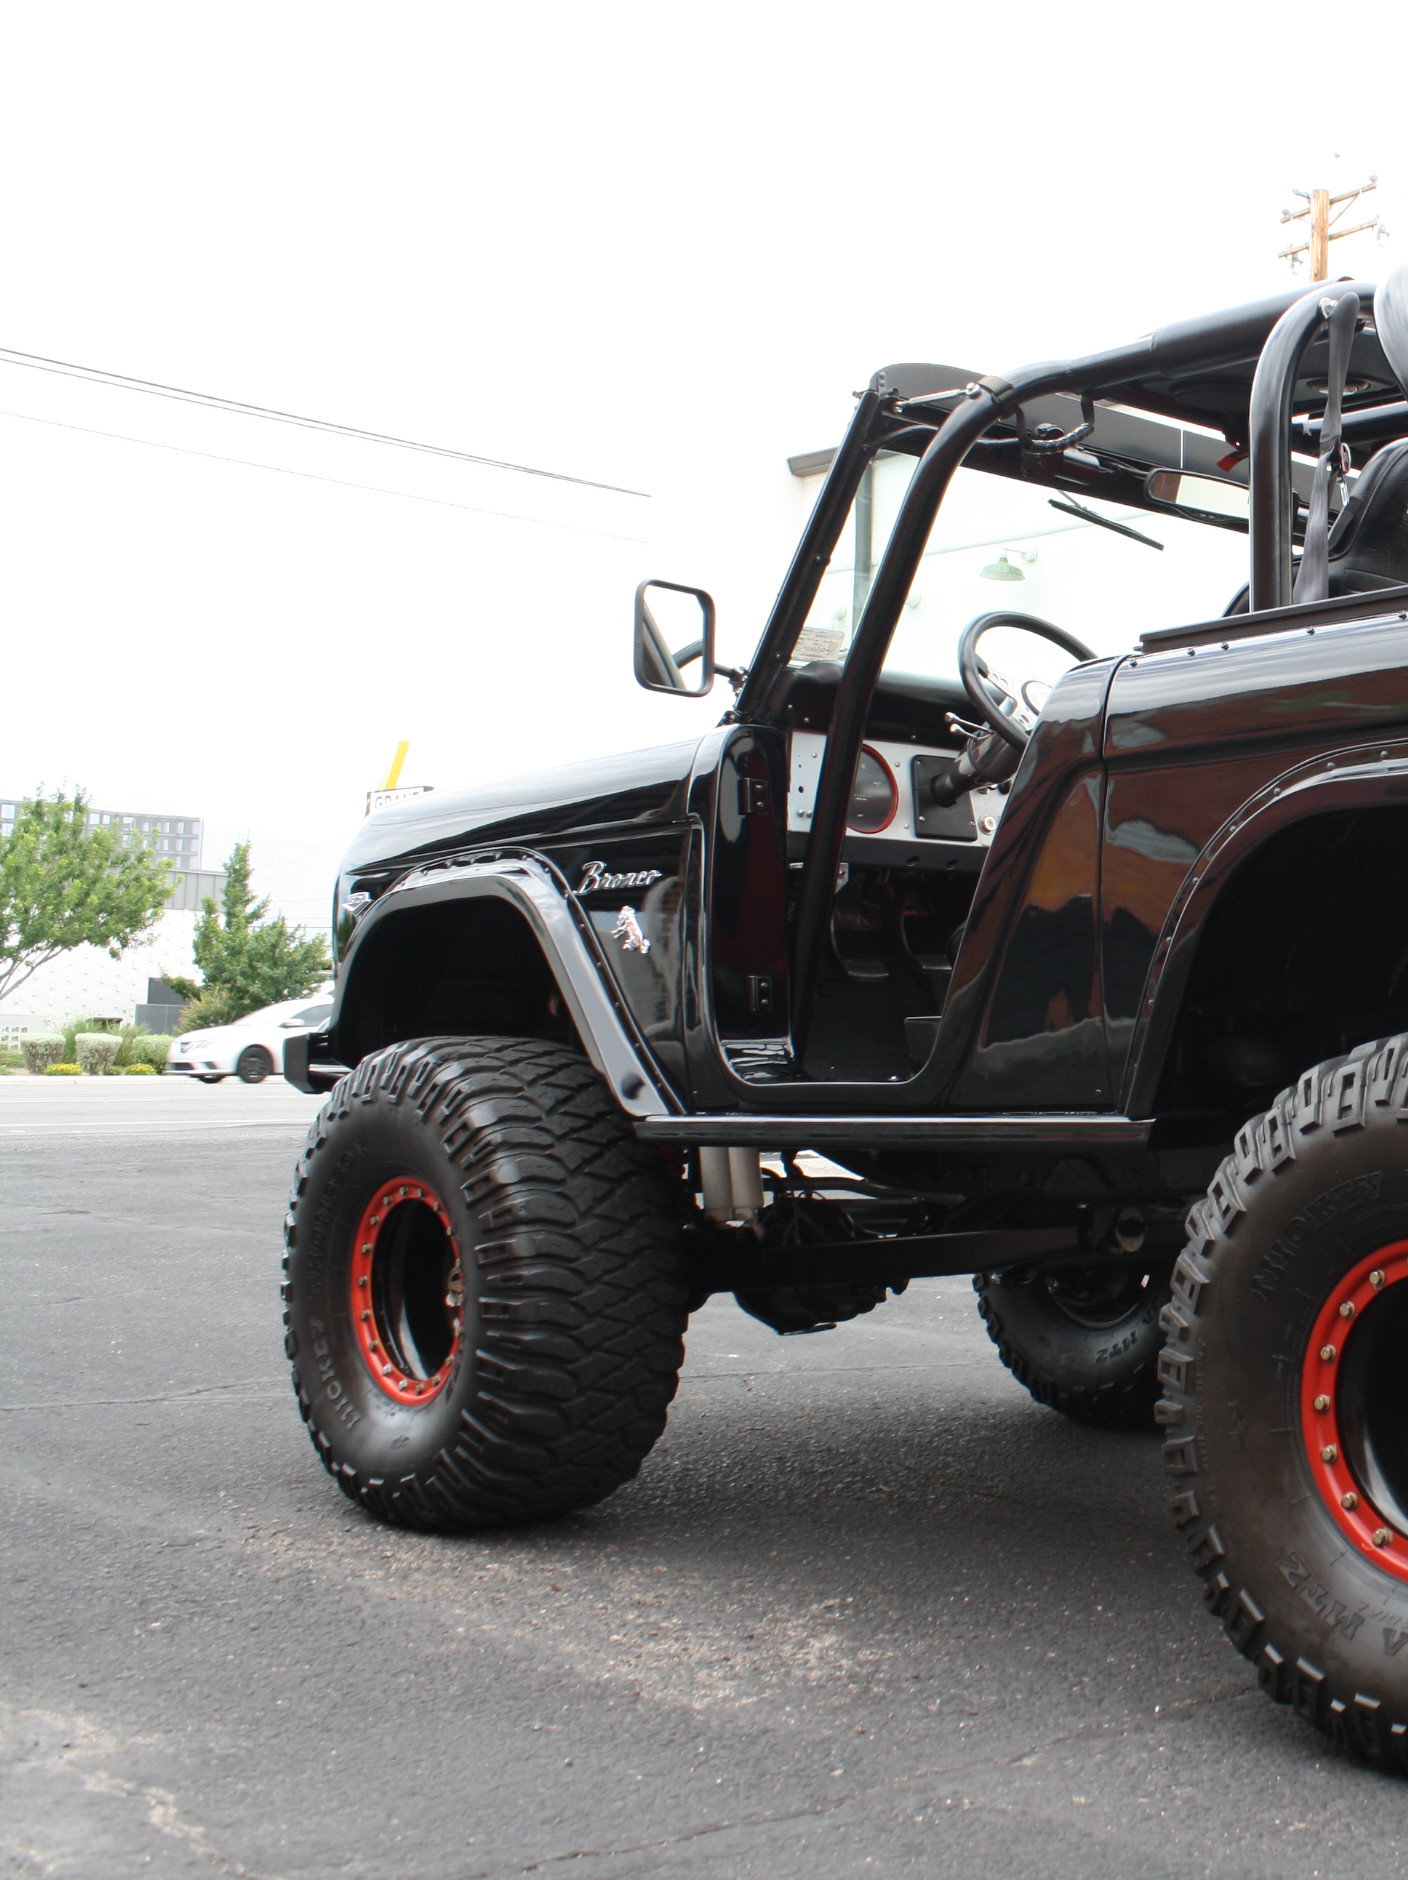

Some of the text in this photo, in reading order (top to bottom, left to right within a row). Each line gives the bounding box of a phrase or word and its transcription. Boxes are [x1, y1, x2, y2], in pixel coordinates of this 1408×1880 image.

[572, 861, 662, 895] Bronco
[1247, 1170, 1382, 1303] MICKEY
[310, 1318, 361, 1432] MICKEY
[1276, 1551, 1366, 1641] MTZ
